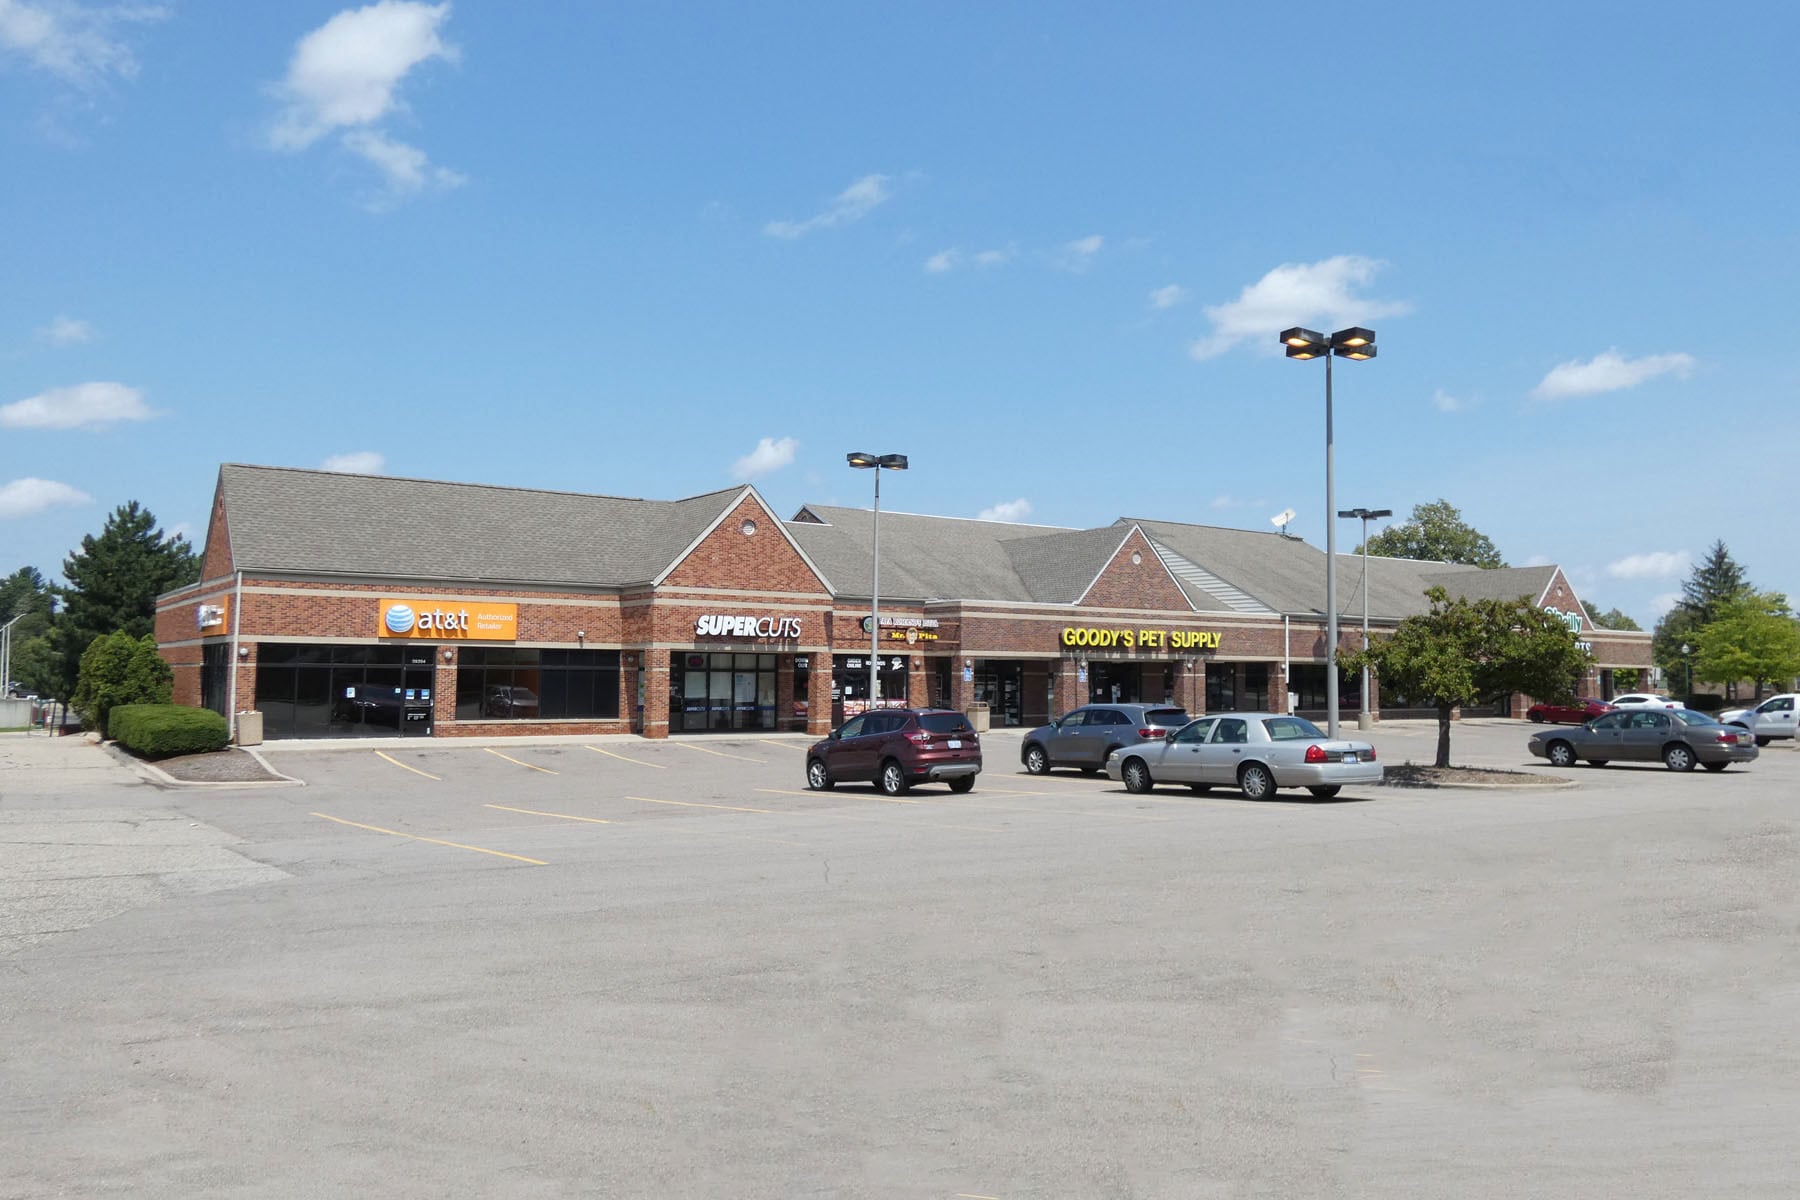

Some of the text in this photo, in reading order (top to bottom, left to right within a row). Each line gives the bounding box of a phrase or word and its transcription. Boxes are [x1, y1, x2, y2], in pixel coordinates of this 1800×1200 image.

[418, 608, 469, 631] at&t
[695, 615, 802, 638] SUPERCUTS
[891, 631, 938, 640] Mr. Pita
[1062, 627, 1221, 649] GOODY'S PET SUPPLY
